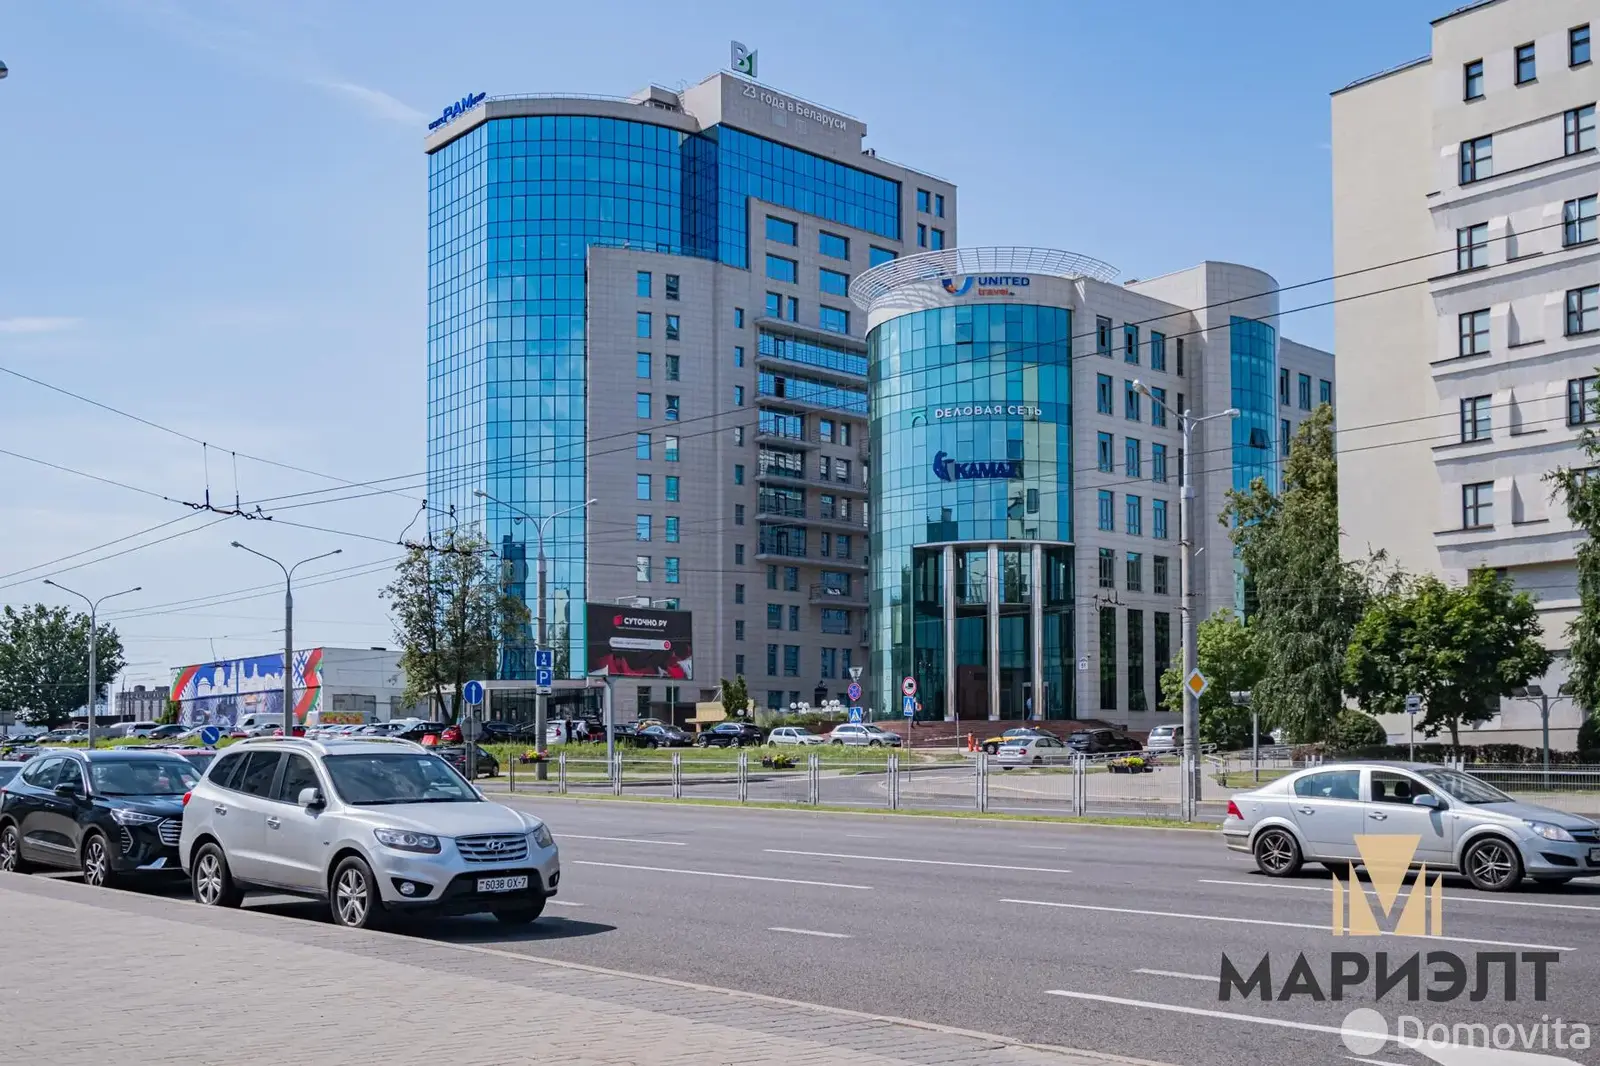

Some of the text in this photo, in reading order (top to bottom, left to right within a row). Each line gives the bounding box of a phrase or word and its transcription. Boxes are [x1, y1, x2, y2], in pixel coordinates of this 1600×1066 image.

[743, 84, 846, 130] 23 года в Беларуси
[978, 276, 1030, 286] UNITED
[540, 671, 548, 684] P
[485, 879, 504, 890] 6038
